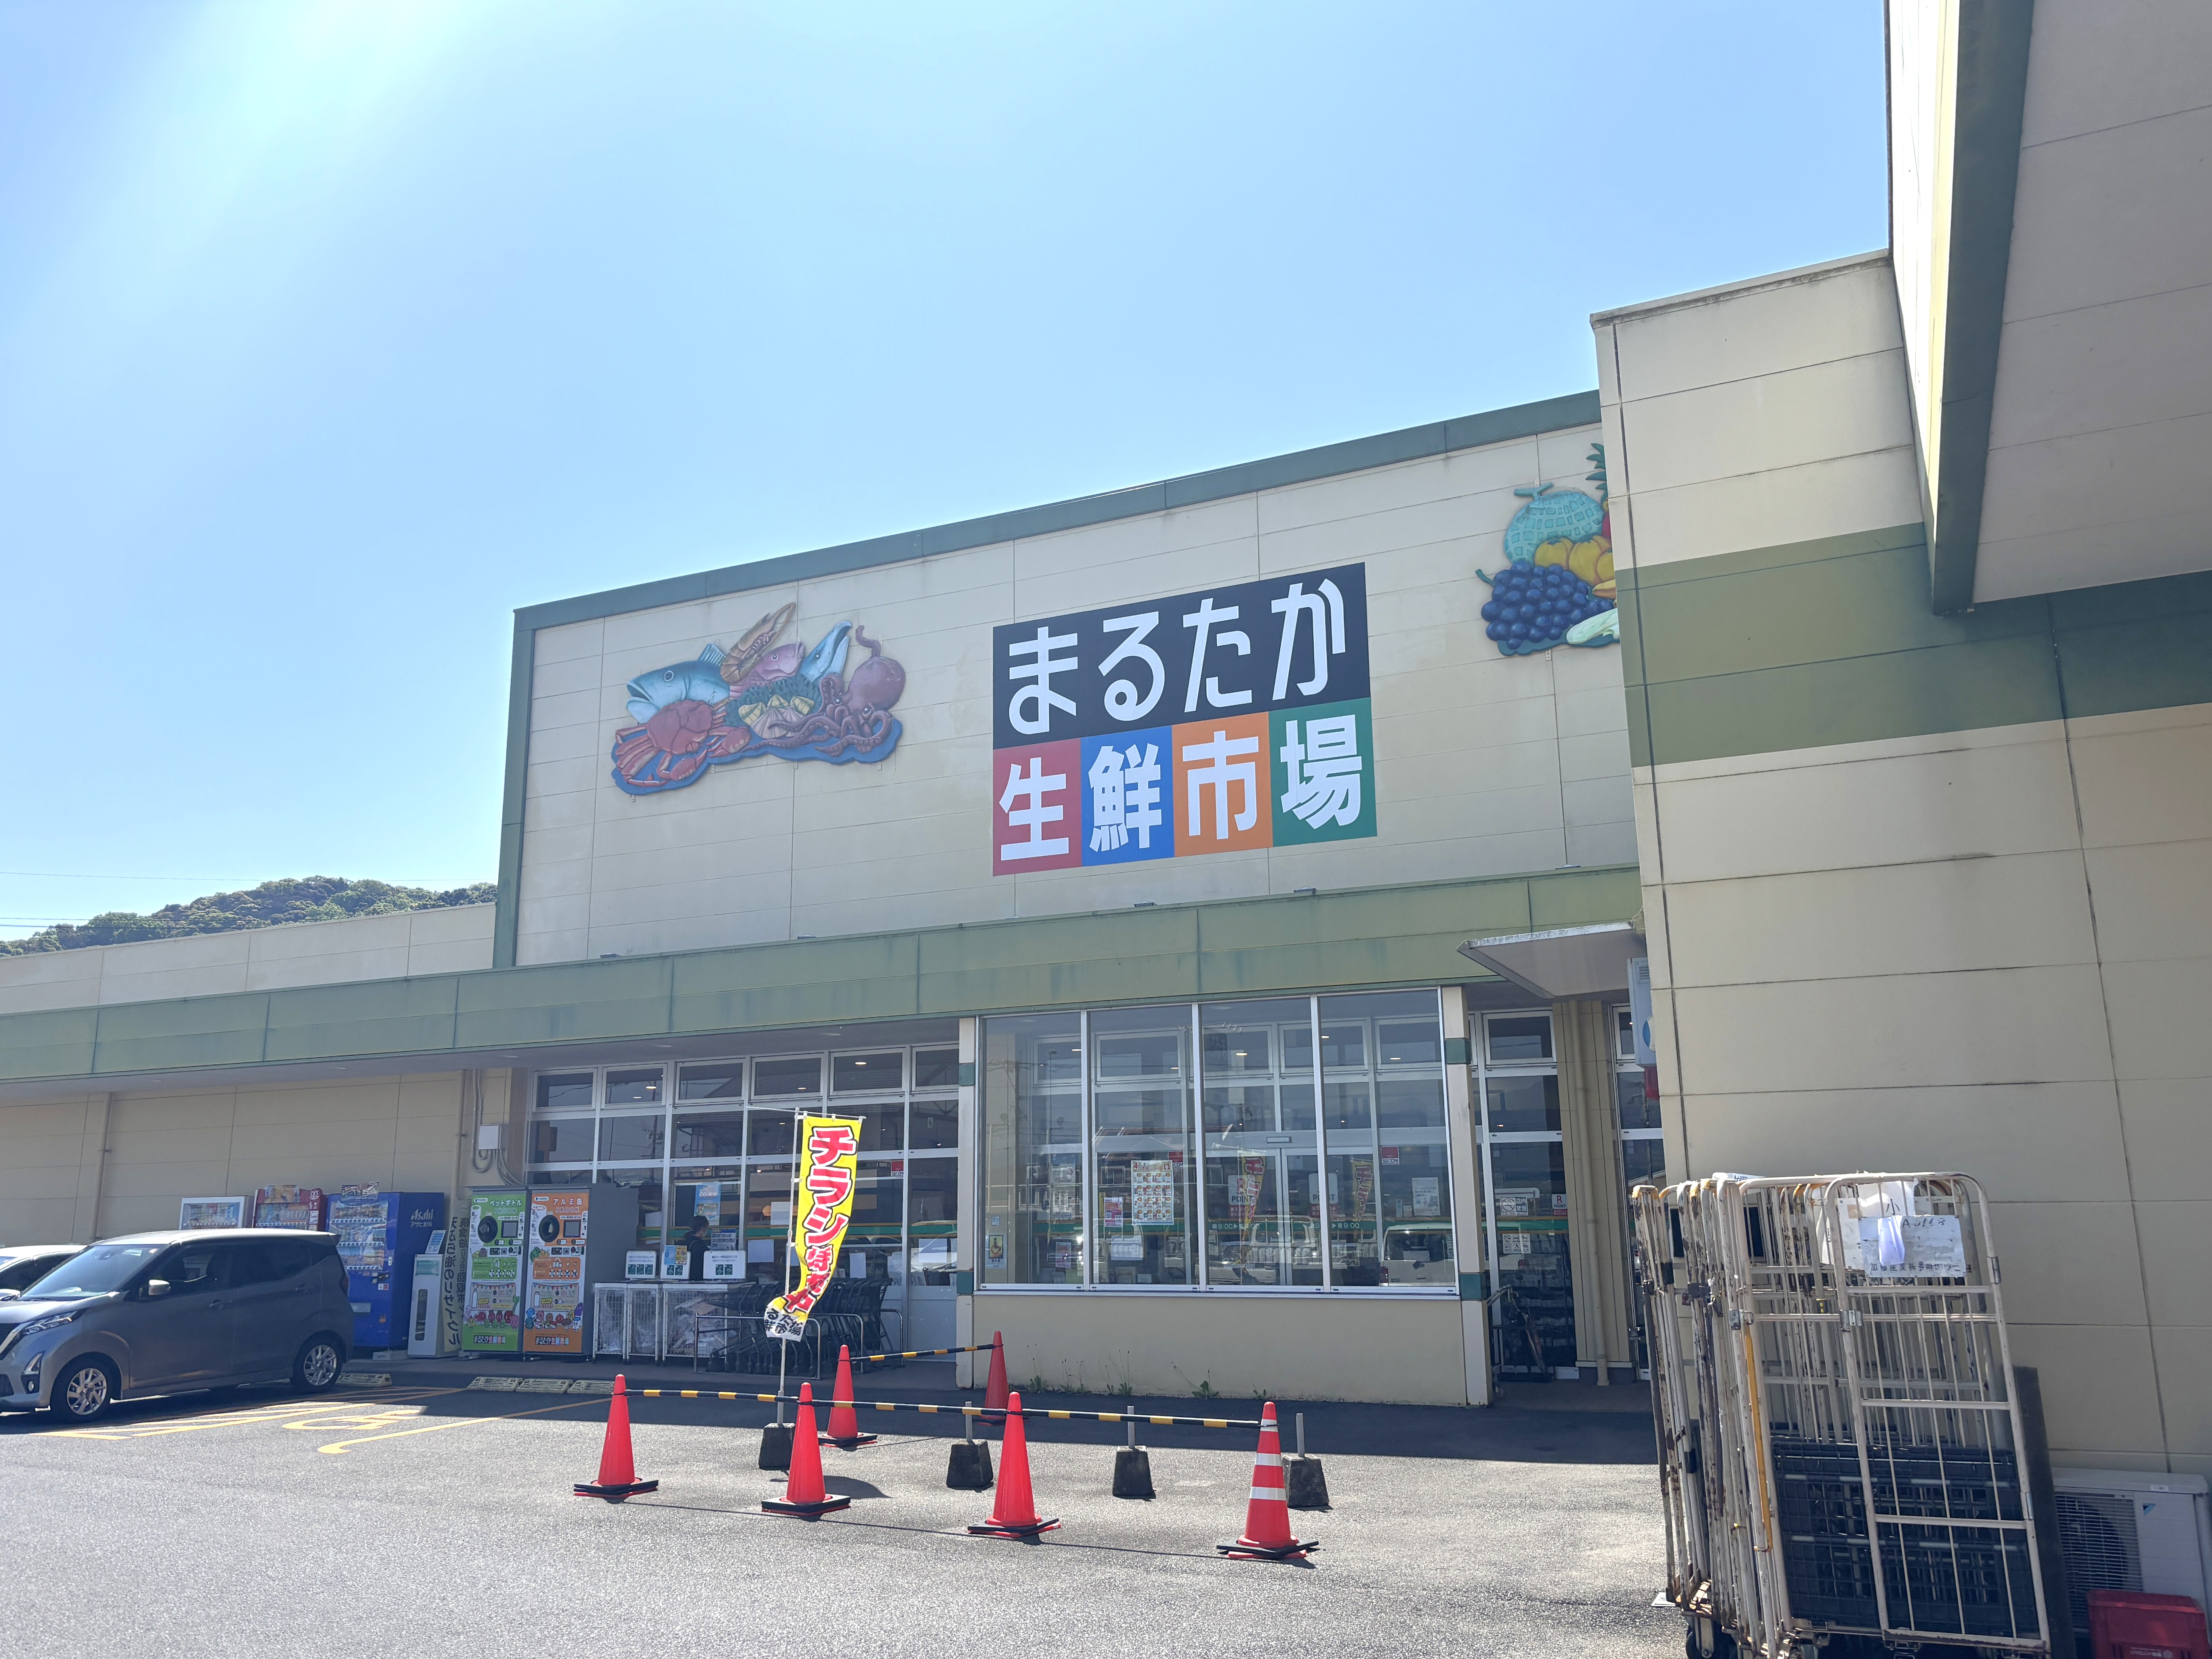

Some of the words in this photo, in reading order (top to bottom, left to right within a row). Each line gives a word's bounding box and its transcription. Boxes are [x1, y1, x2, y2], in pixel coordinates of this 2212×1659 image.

[1009, 578, 1346, 735] まるたか
[999, 715, 1362, 861] 生鮮市場
[411, 1209, 434, 1220] Asahi
